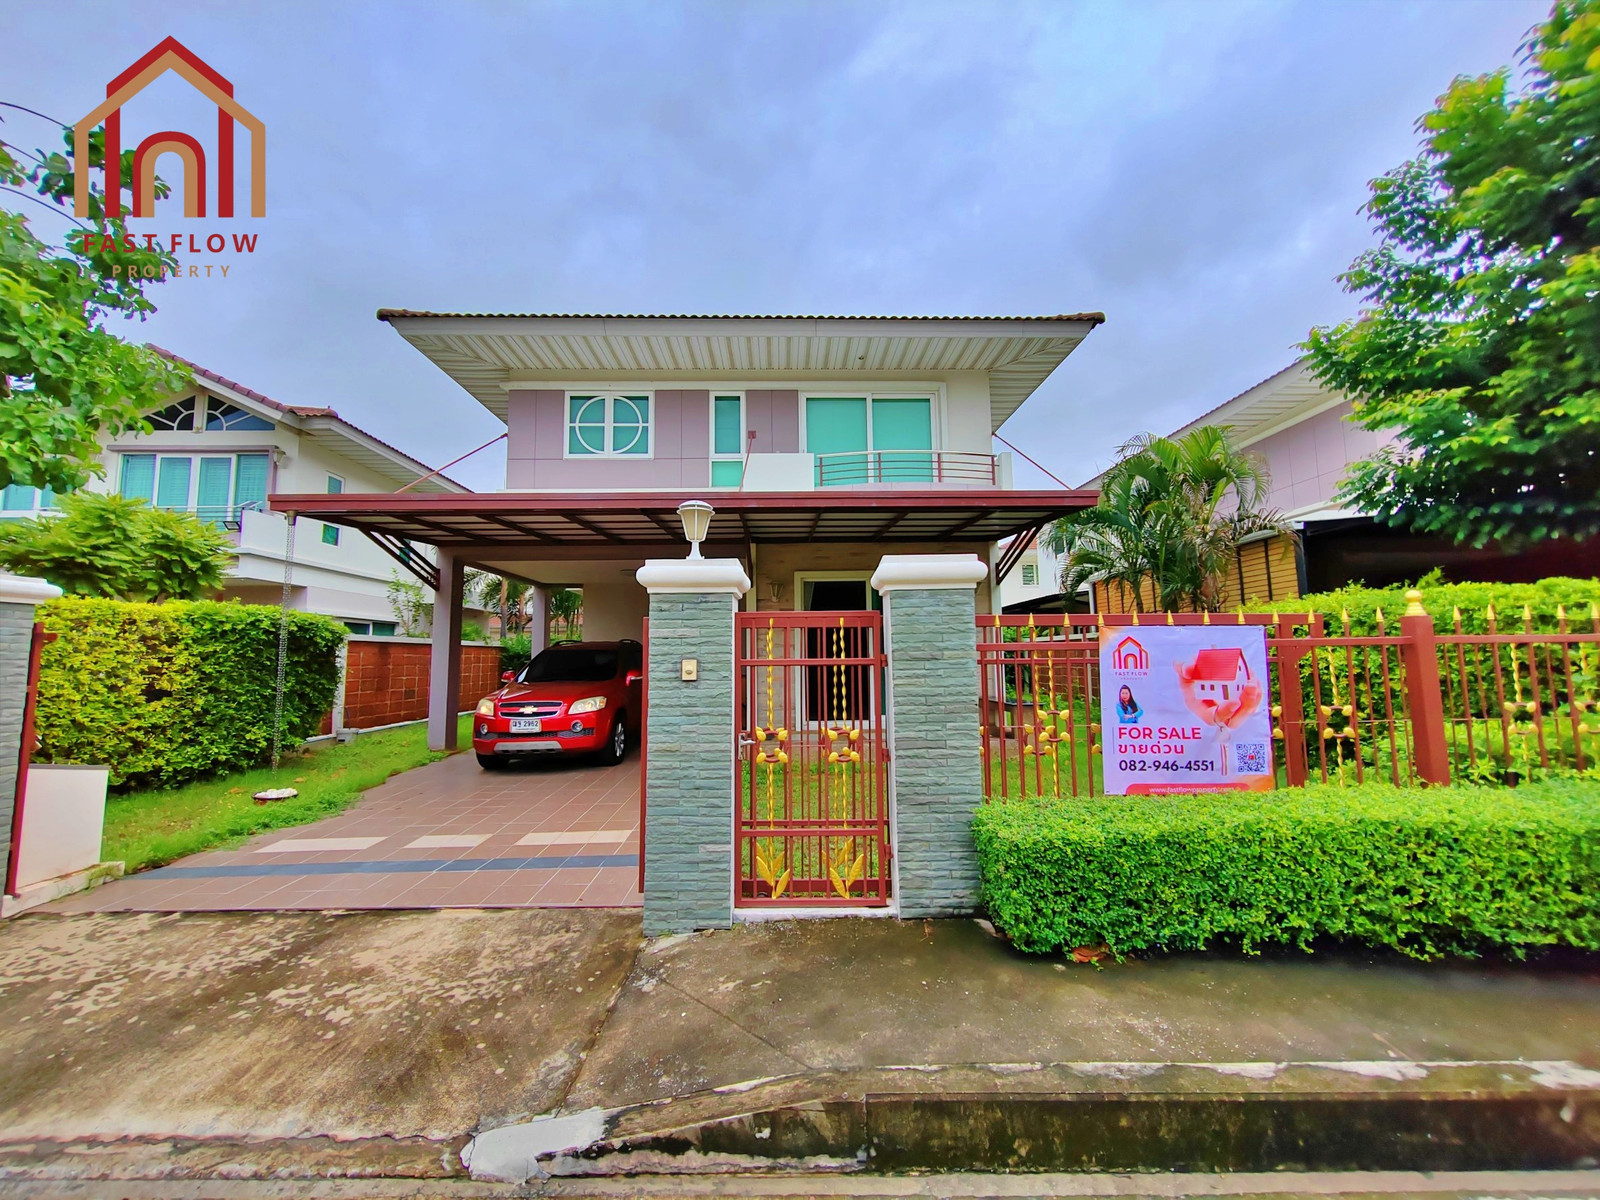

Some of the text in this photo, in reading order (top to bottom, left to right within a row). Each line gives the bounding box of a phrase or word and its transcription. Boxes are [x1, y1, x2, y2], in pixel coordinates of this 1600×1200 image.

[1118, 727, 1202, 740] FOR SALE
[1118, 740, 1185, 754] ขายด่วน
[1119, 760, 1215, 772] 082-946-4551
